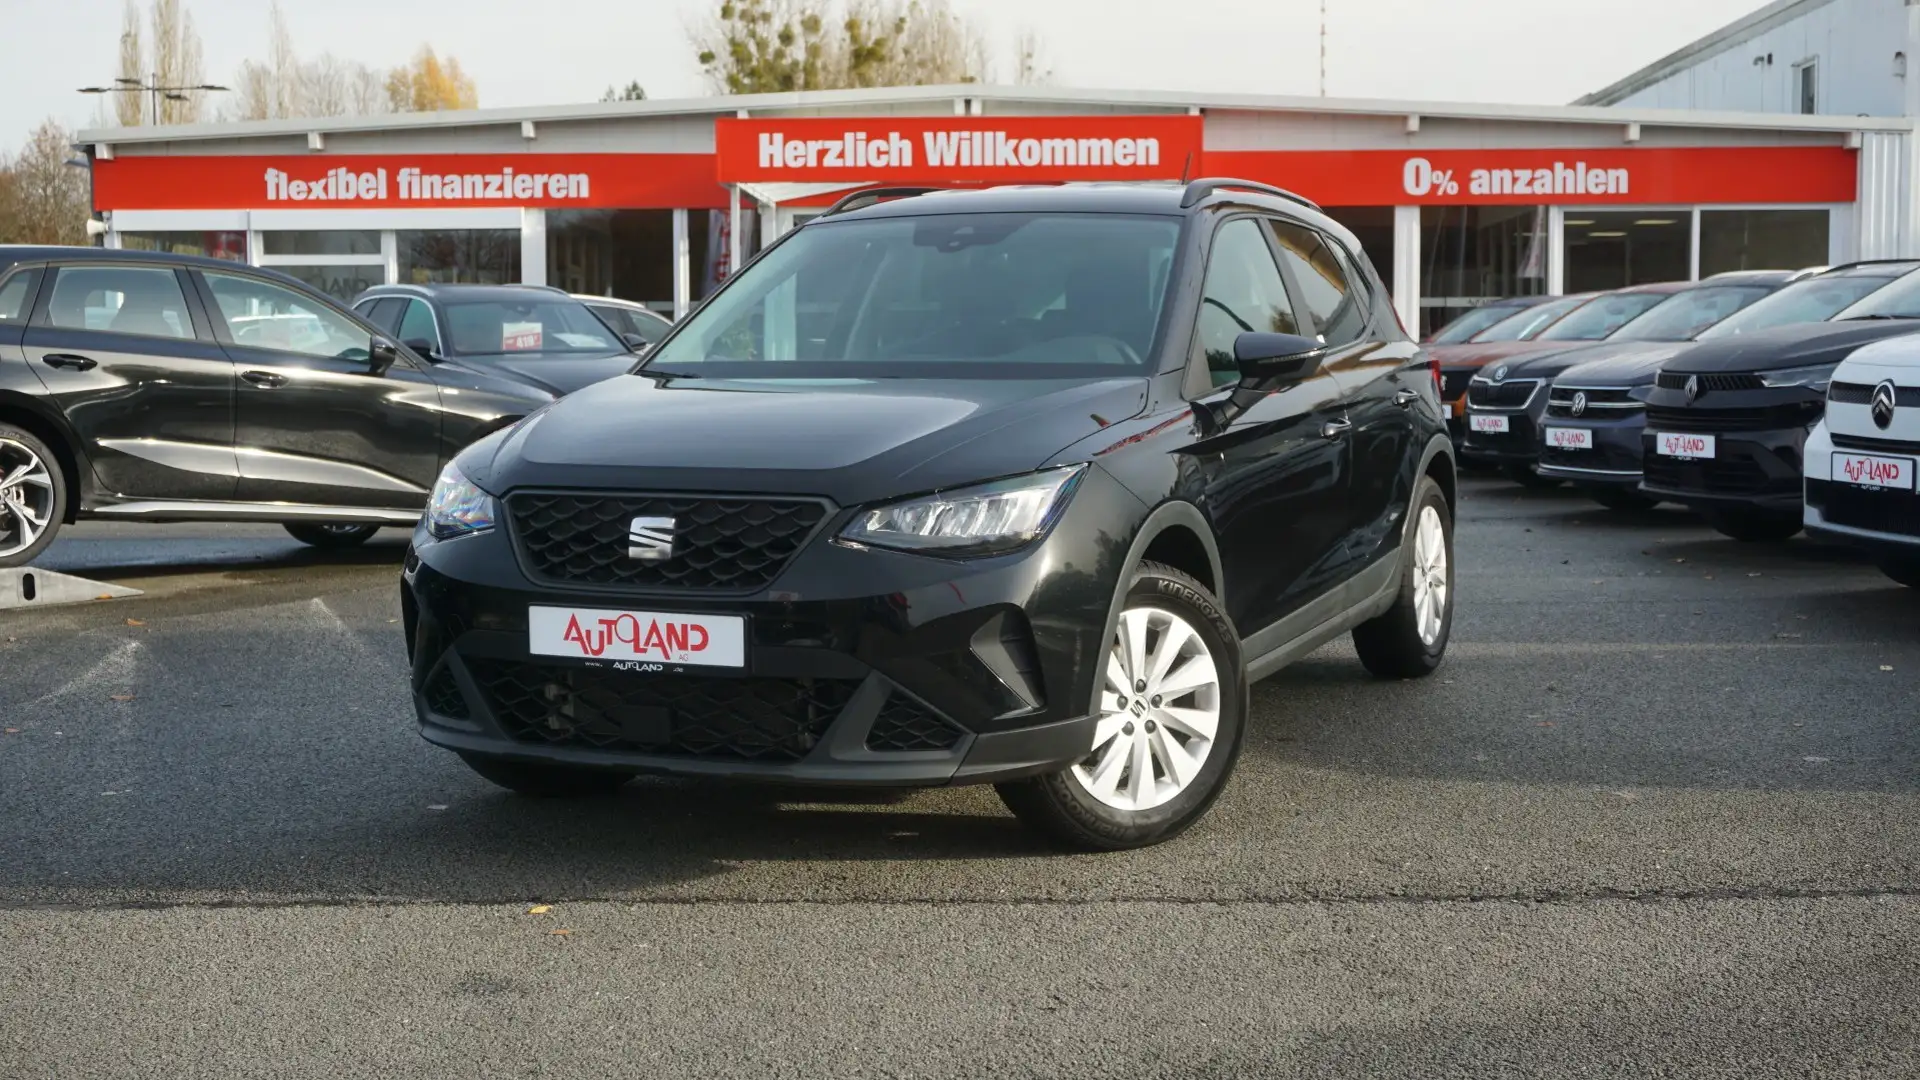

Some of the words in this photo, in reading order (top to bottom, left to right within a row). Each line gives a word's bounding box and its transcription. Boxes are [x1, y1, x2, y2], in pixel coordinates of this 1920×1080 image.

[758, 132, 912, 168] Herzlich
[923, 131, 1160, 167] Willkommen
[264, 167, 387, 200] flexibel
[397, 167, 590, 199] finanzieren
[1403, 157, 1459, 196] 0%
[1469, 161, 1629, 195] anzahlen
[1844, 457, 1900, 484] AUTOLAND
[563, 612, 710, 661] AUTOLAND
[612, 661, 664, 672] AUTOLAND
